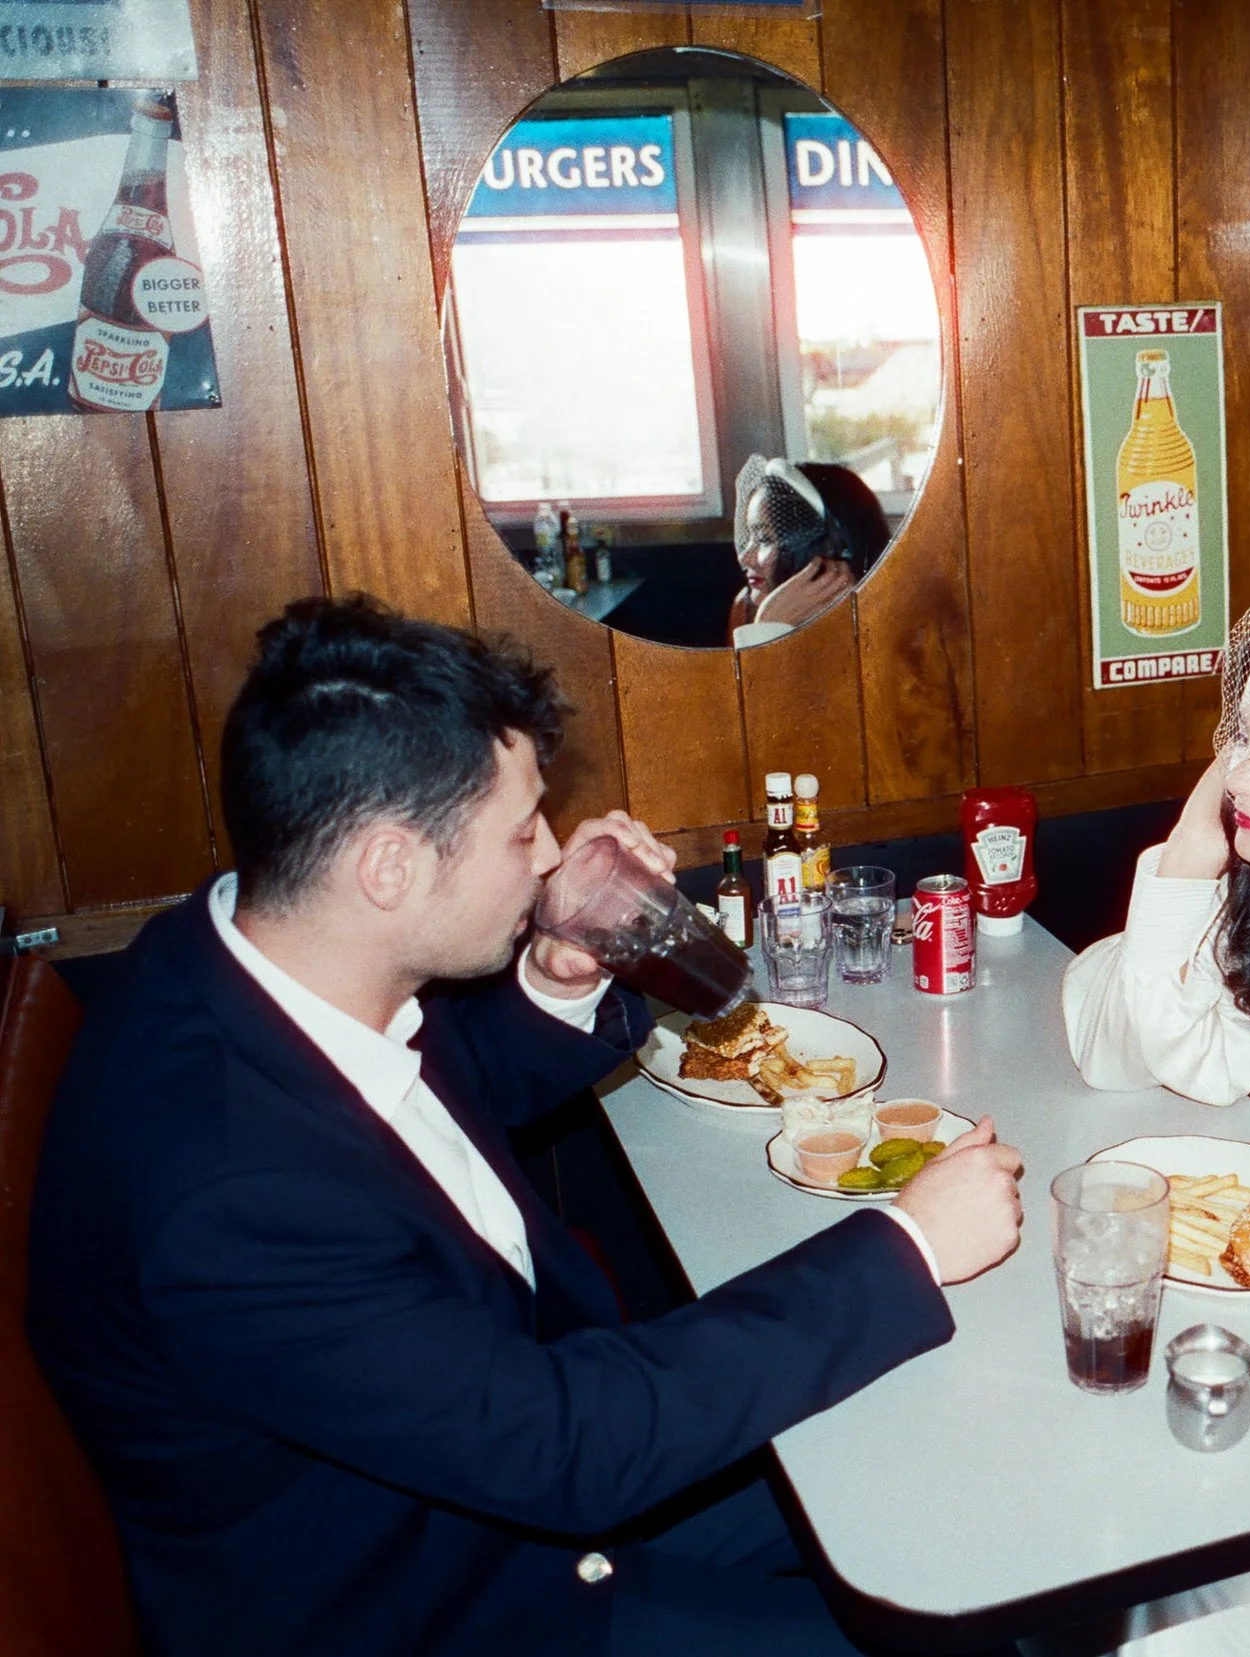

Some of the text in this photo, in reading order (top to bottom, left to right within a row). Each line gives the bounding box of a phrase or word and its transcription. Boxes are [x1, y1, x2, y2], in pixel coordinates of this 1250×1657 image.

[142, 278, 201, 291] BIGGER
[147, 300, 201, 313] BETTER
[1119, 487, 1193, 518] Twinkle
